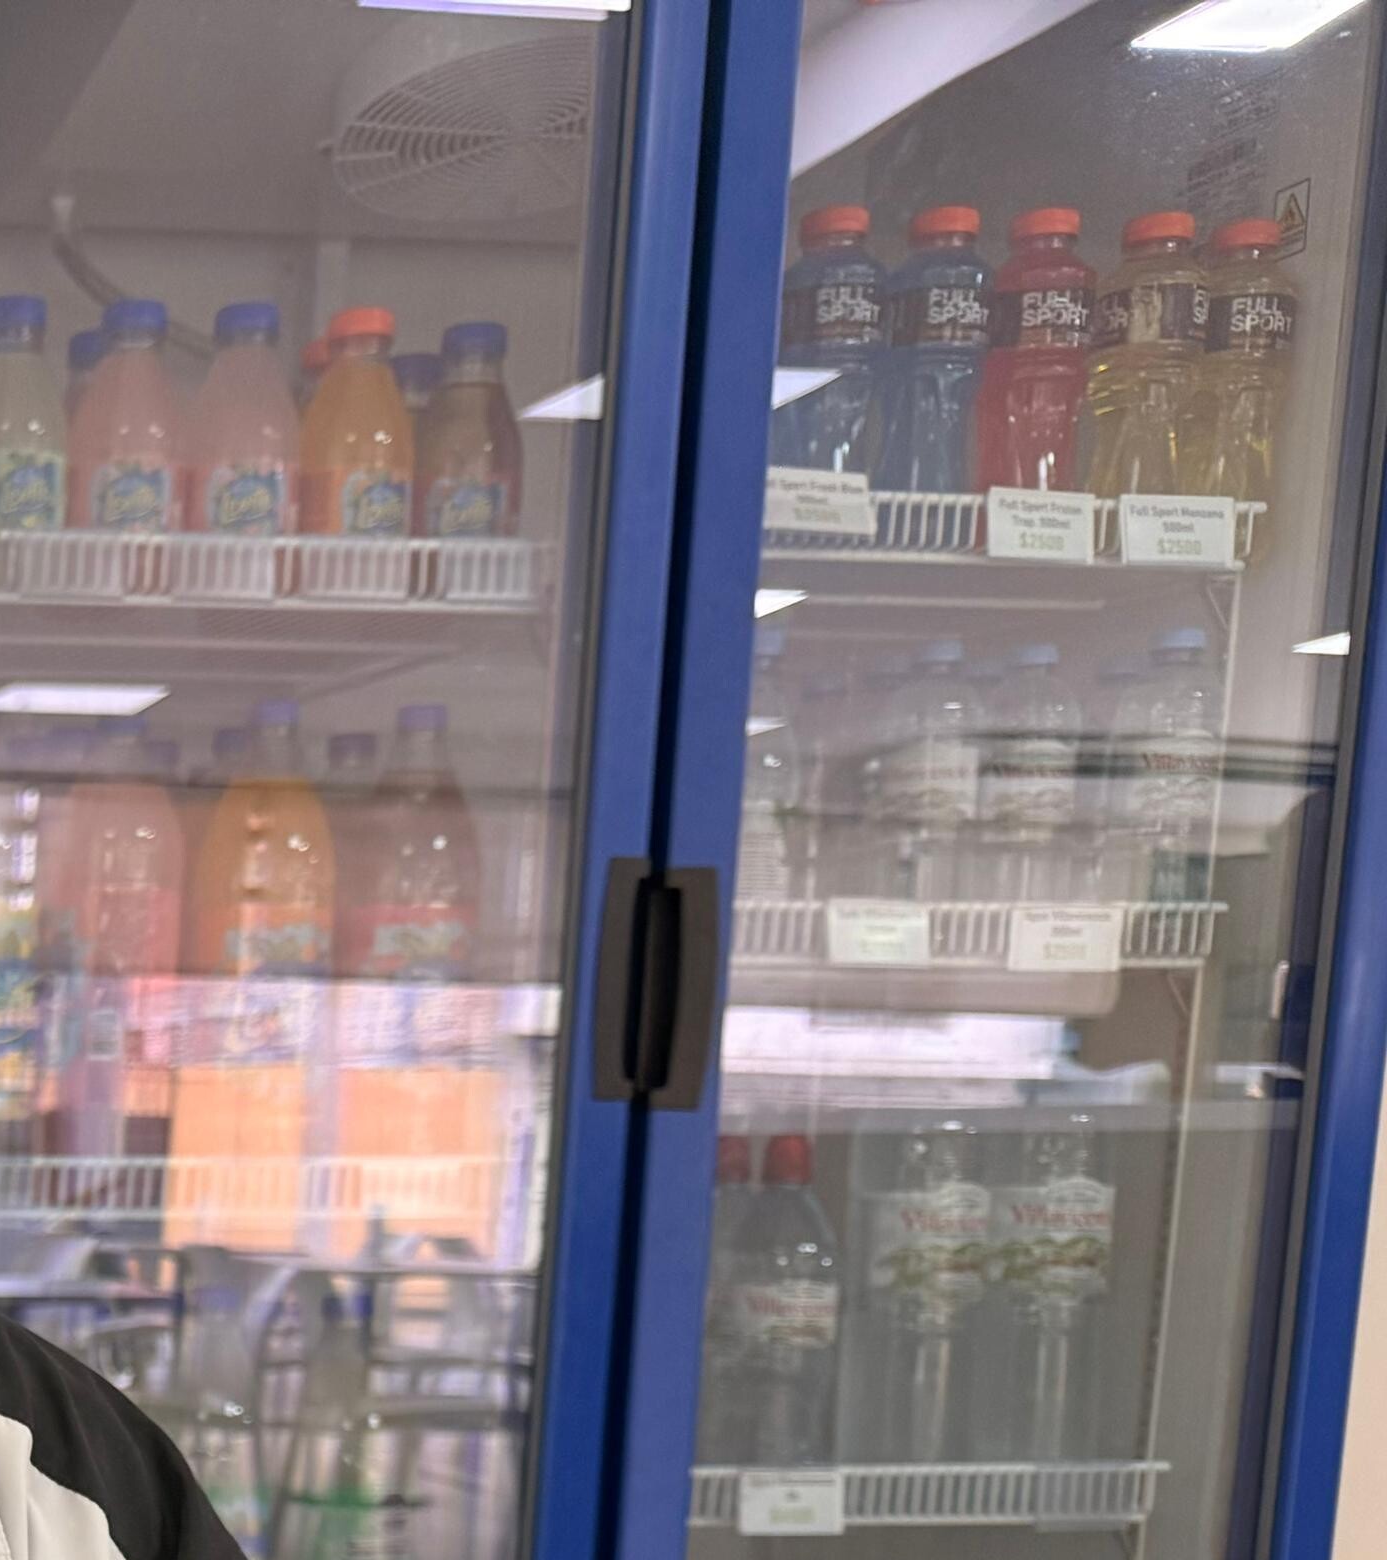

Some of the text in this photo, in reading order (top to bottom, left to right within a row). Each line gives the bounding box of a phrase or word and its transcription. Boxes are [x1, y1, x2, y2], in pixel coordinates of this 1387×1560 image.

[817, 286, 867, 304] FULL
[929, 287, 976, 304] FULL
[1022, 290, 1083, 311] FULL
[1231, 296, 1282, 314] FULL
[817, 300, 881, 324] SPORT
[927, 302, 990, 325] SPORT
[1021, 306, 1090, 328] SPORT
[1229, 313, 1292, 335] SPORT
